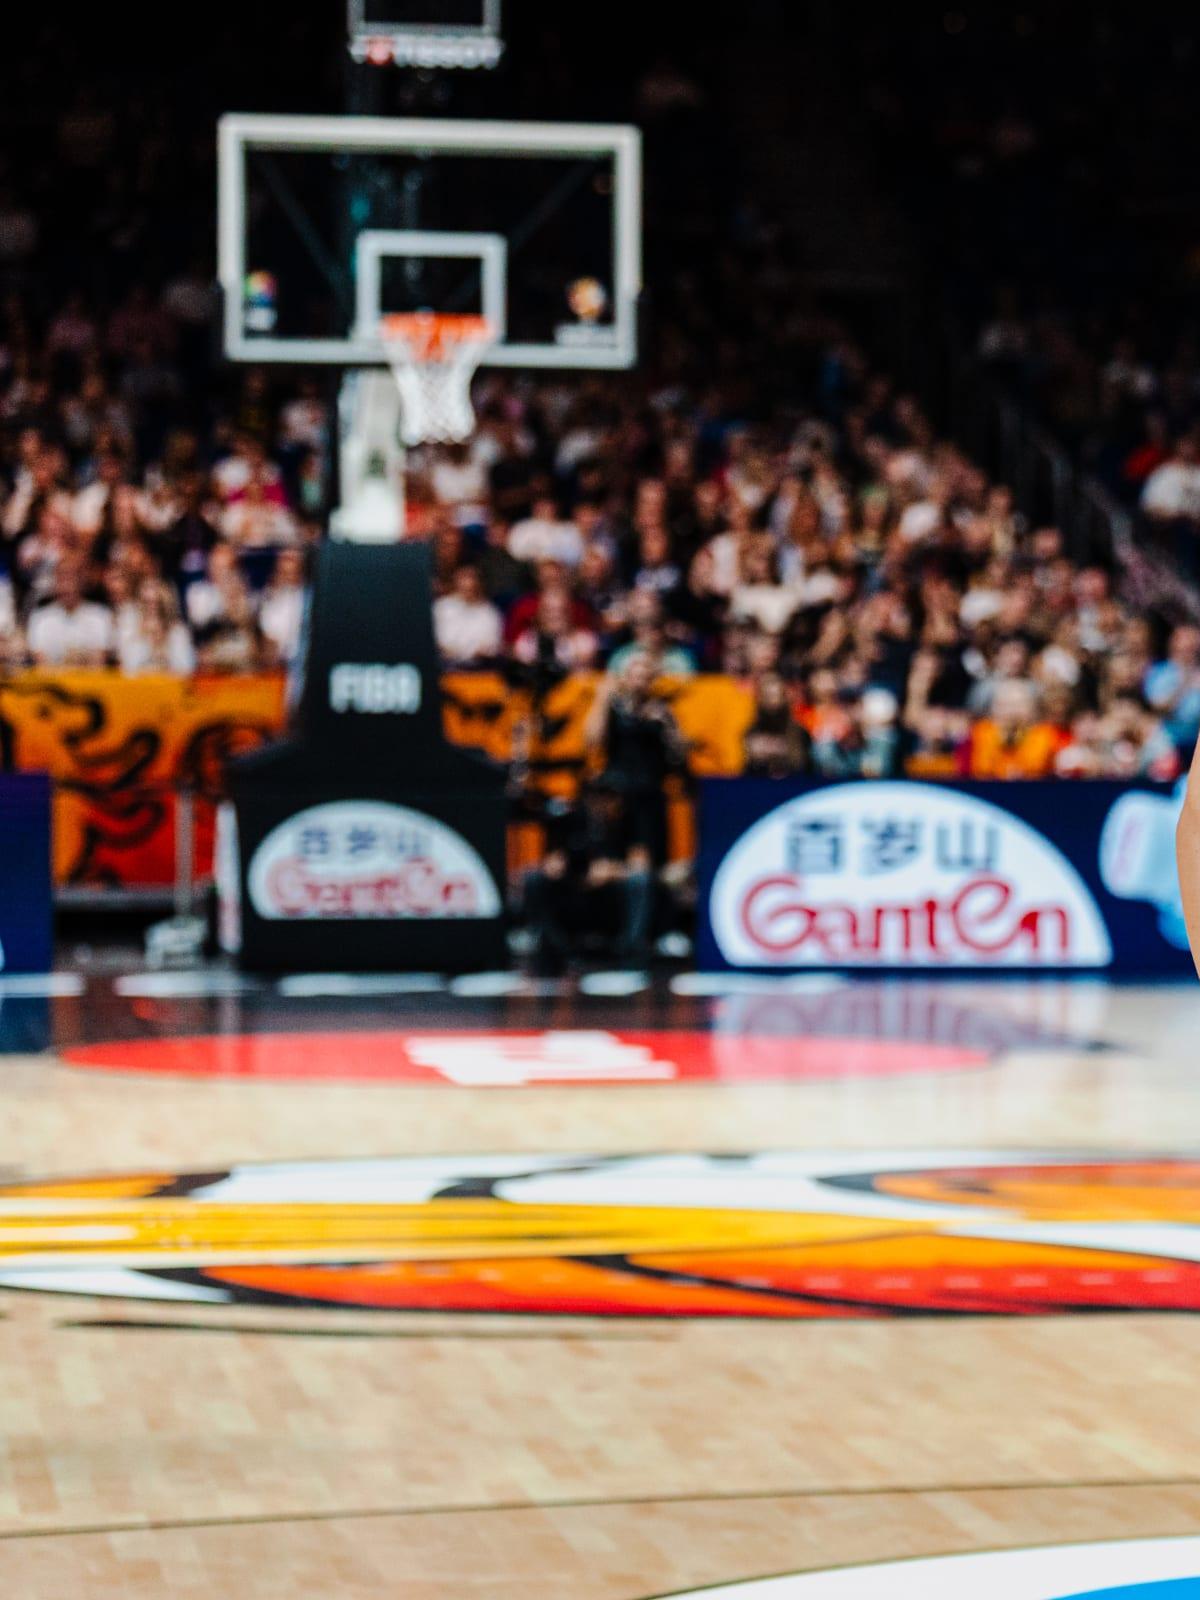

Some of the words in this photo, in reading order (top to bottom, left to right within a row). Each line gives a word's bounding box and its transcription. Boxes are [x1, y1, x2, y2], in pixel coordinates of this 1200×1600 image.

[329, 662, 421, 714] FIBA
[785, 813, 999, 875] 百岁山
